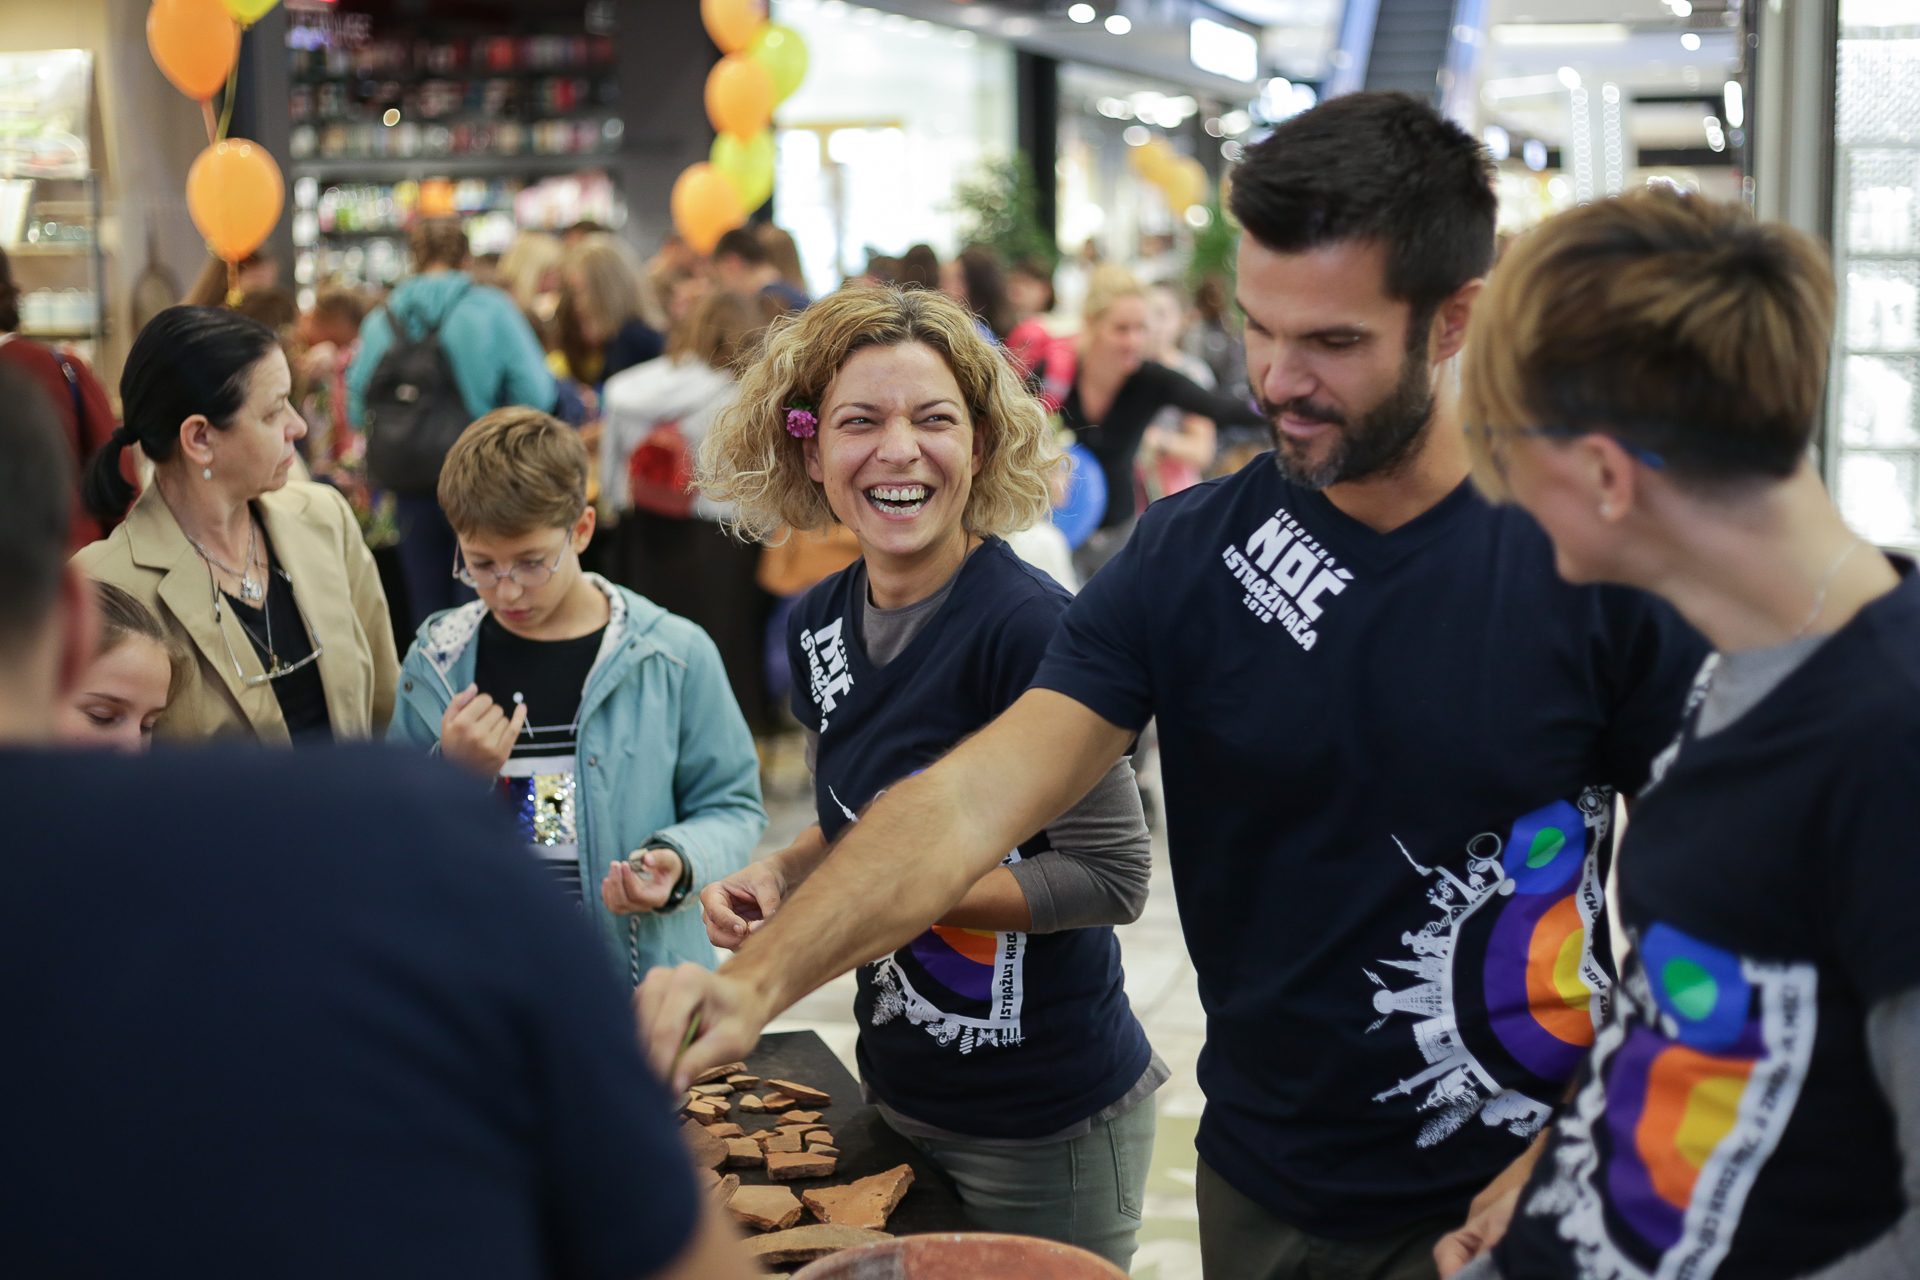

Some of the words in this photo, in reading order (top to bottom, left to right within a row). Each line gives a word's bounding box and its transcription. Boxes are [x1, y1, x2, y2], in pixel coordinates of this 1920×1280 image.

[1274, 508, 1336, 568] EVROPSKA
[1221, 544, 1318, 652] ISTRAŽIVAČA
[1245, 516, 1354, 622] NOĆ
[1242, 593, 1274, 623] 2018
[998, 963, 1014, 1020] ISTRAŽUJ
